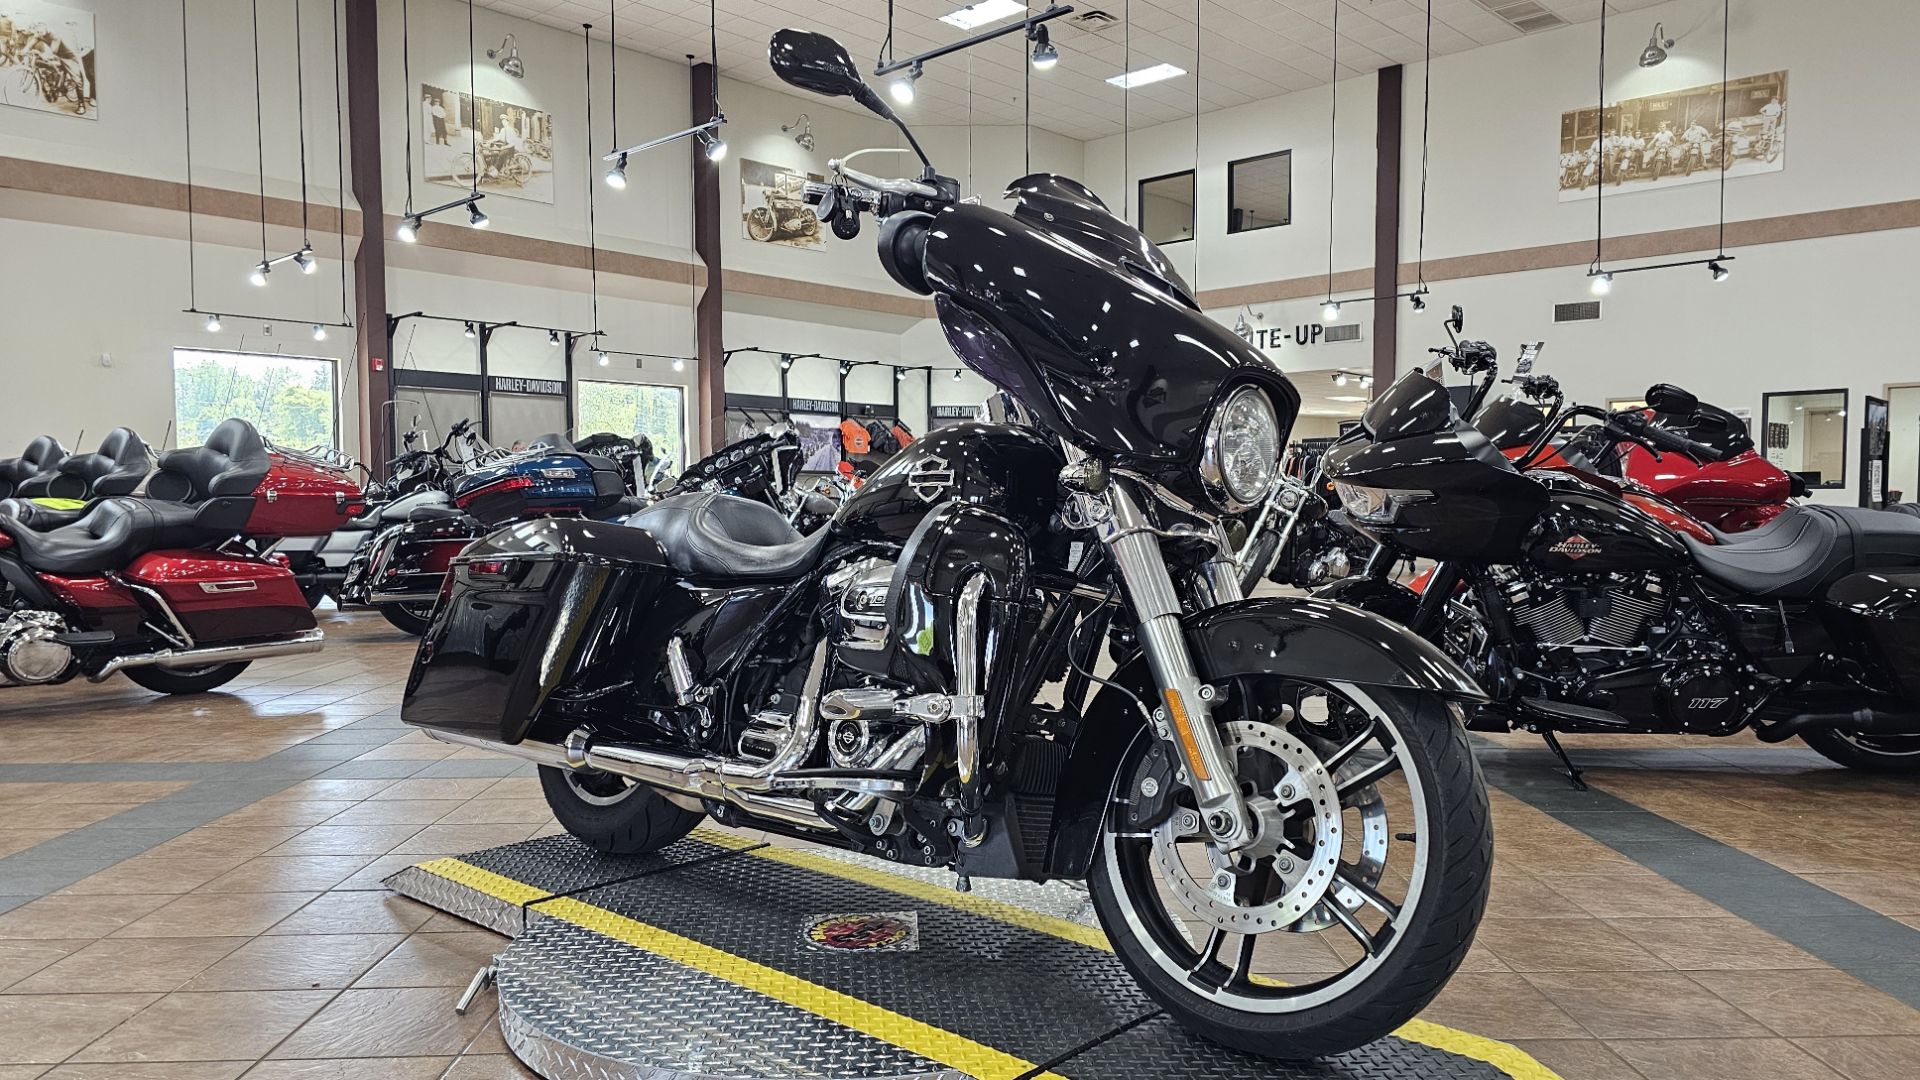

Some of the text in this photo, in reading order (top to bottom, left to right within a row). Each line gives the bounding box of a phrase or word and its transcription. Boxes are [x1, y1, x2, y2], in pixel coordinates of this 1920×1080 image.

[495, 377, 562, 394] HARLEY-DAVIDSON
[792, 399, 839, 412] HARLEY-DAVIDSON
[870, 595, 886, 604] 10
[1688, 697, 1729, 709] 117
